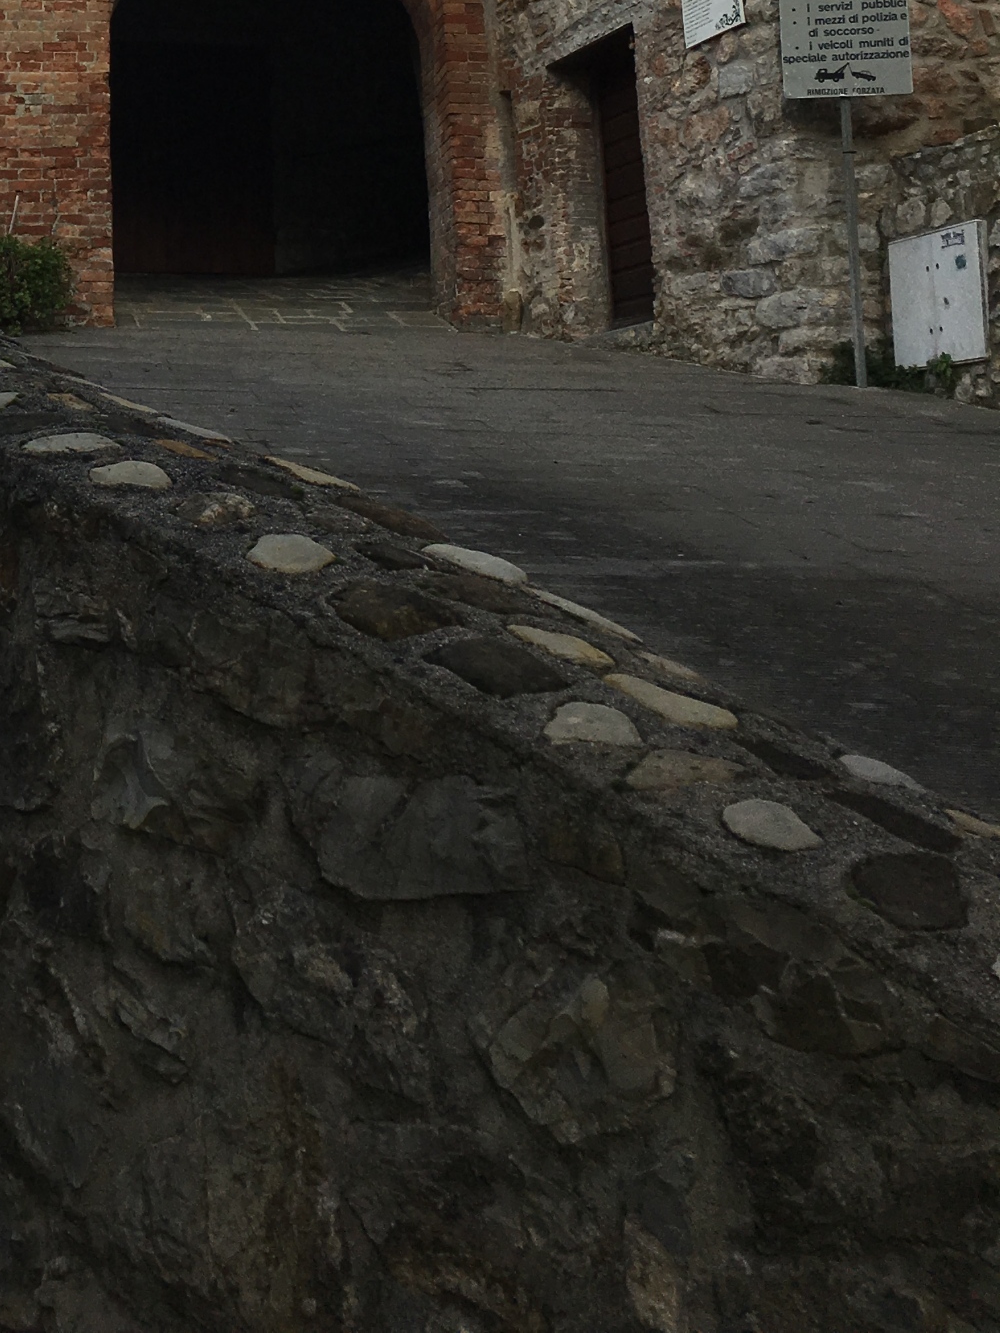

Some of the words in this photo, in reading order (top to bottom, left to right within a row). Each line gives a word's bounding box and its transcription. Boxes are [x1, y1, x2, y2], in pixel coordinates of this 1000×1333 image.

[818, 1, 853, 12] servizi
[814, 14, 846, 26] mezzi
[848, 14, 859, 23] di
[862, 12, 898, 25] polizia
[900, 12, 908, 21] e
[808, 28, 819, 37] di
[823, 26, 875, 37] soccorso
[818, 39, 853, 50] veicoli
[858, 37, 894, 48] muniti
[898, 36, 909, 46] di
[783, 52, 827, 64] speciale
[831, 50, 910, 62] autorizzazione
[807, 88, 849, 96] RIMOZIONE
